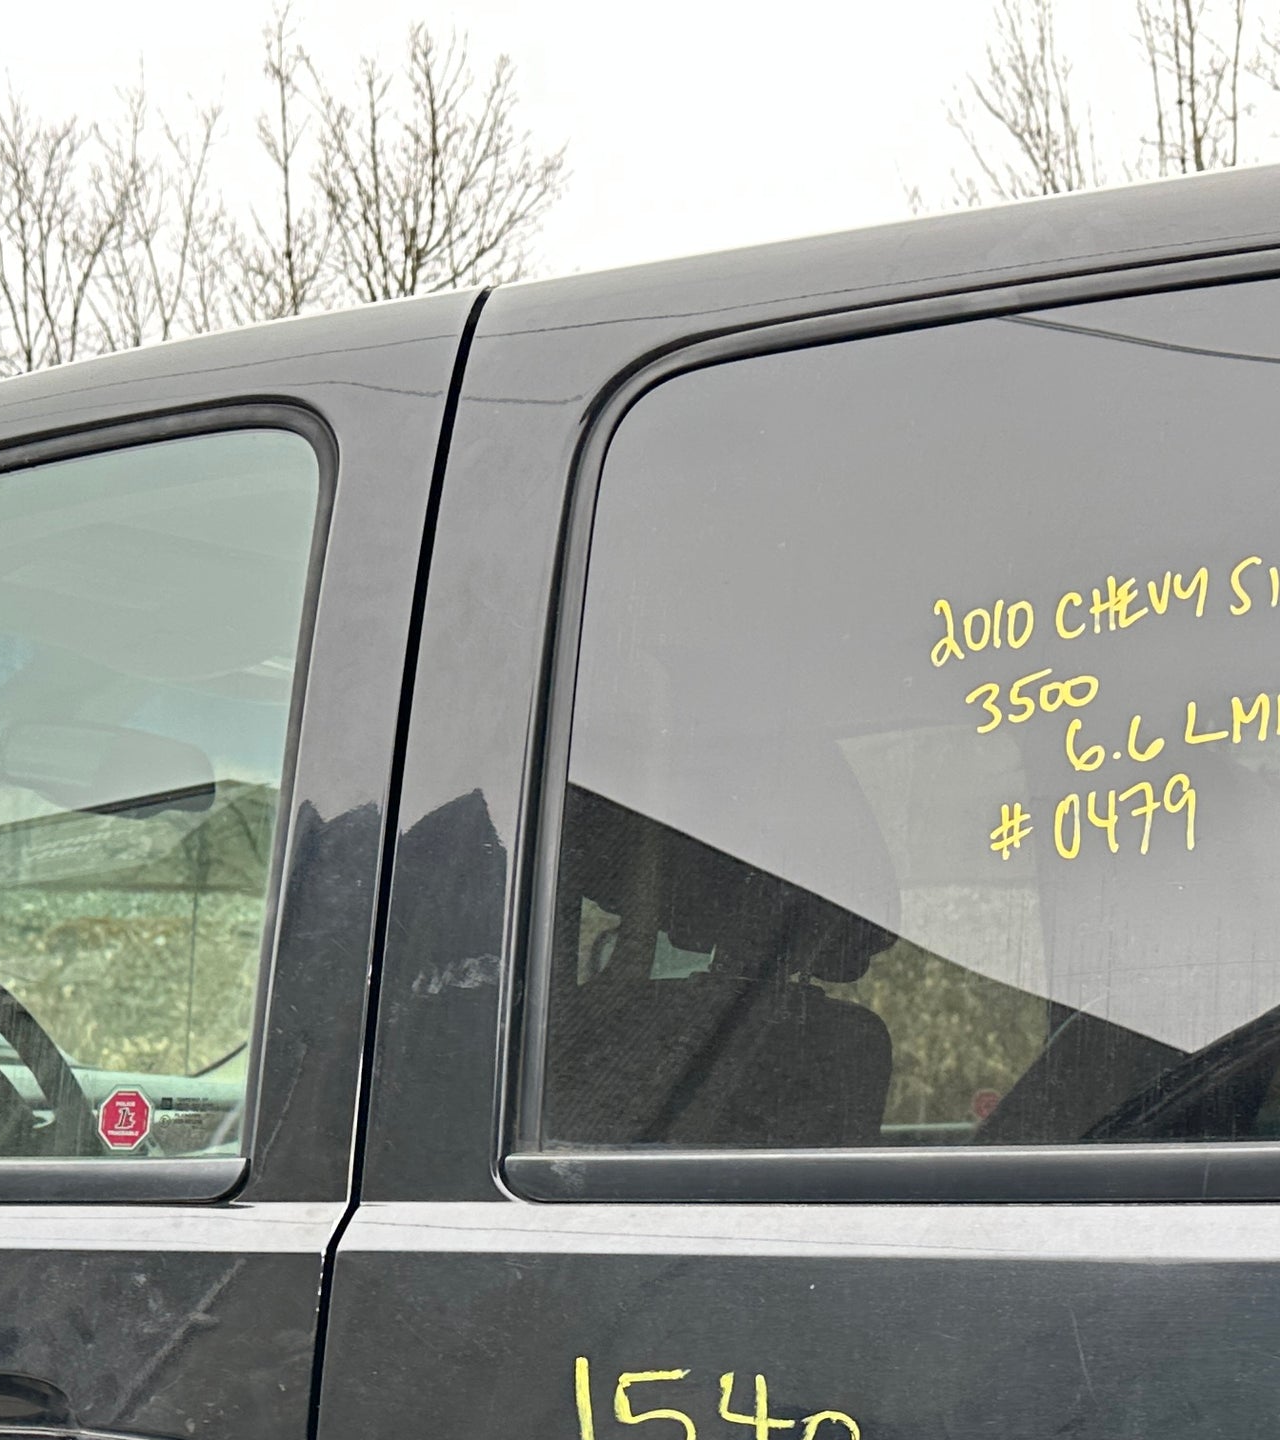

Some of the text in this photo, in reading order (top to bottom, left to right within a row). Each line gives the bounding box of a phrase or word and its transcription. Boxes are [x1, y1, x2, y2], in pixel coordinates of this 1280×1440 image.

[930, 598, 1035, 667] 2010
[1054, 566, 1210, 641] CHEVY
[965, 668, 1099, 734] 3500
[1065, 717, 1166, 772] 6.6
